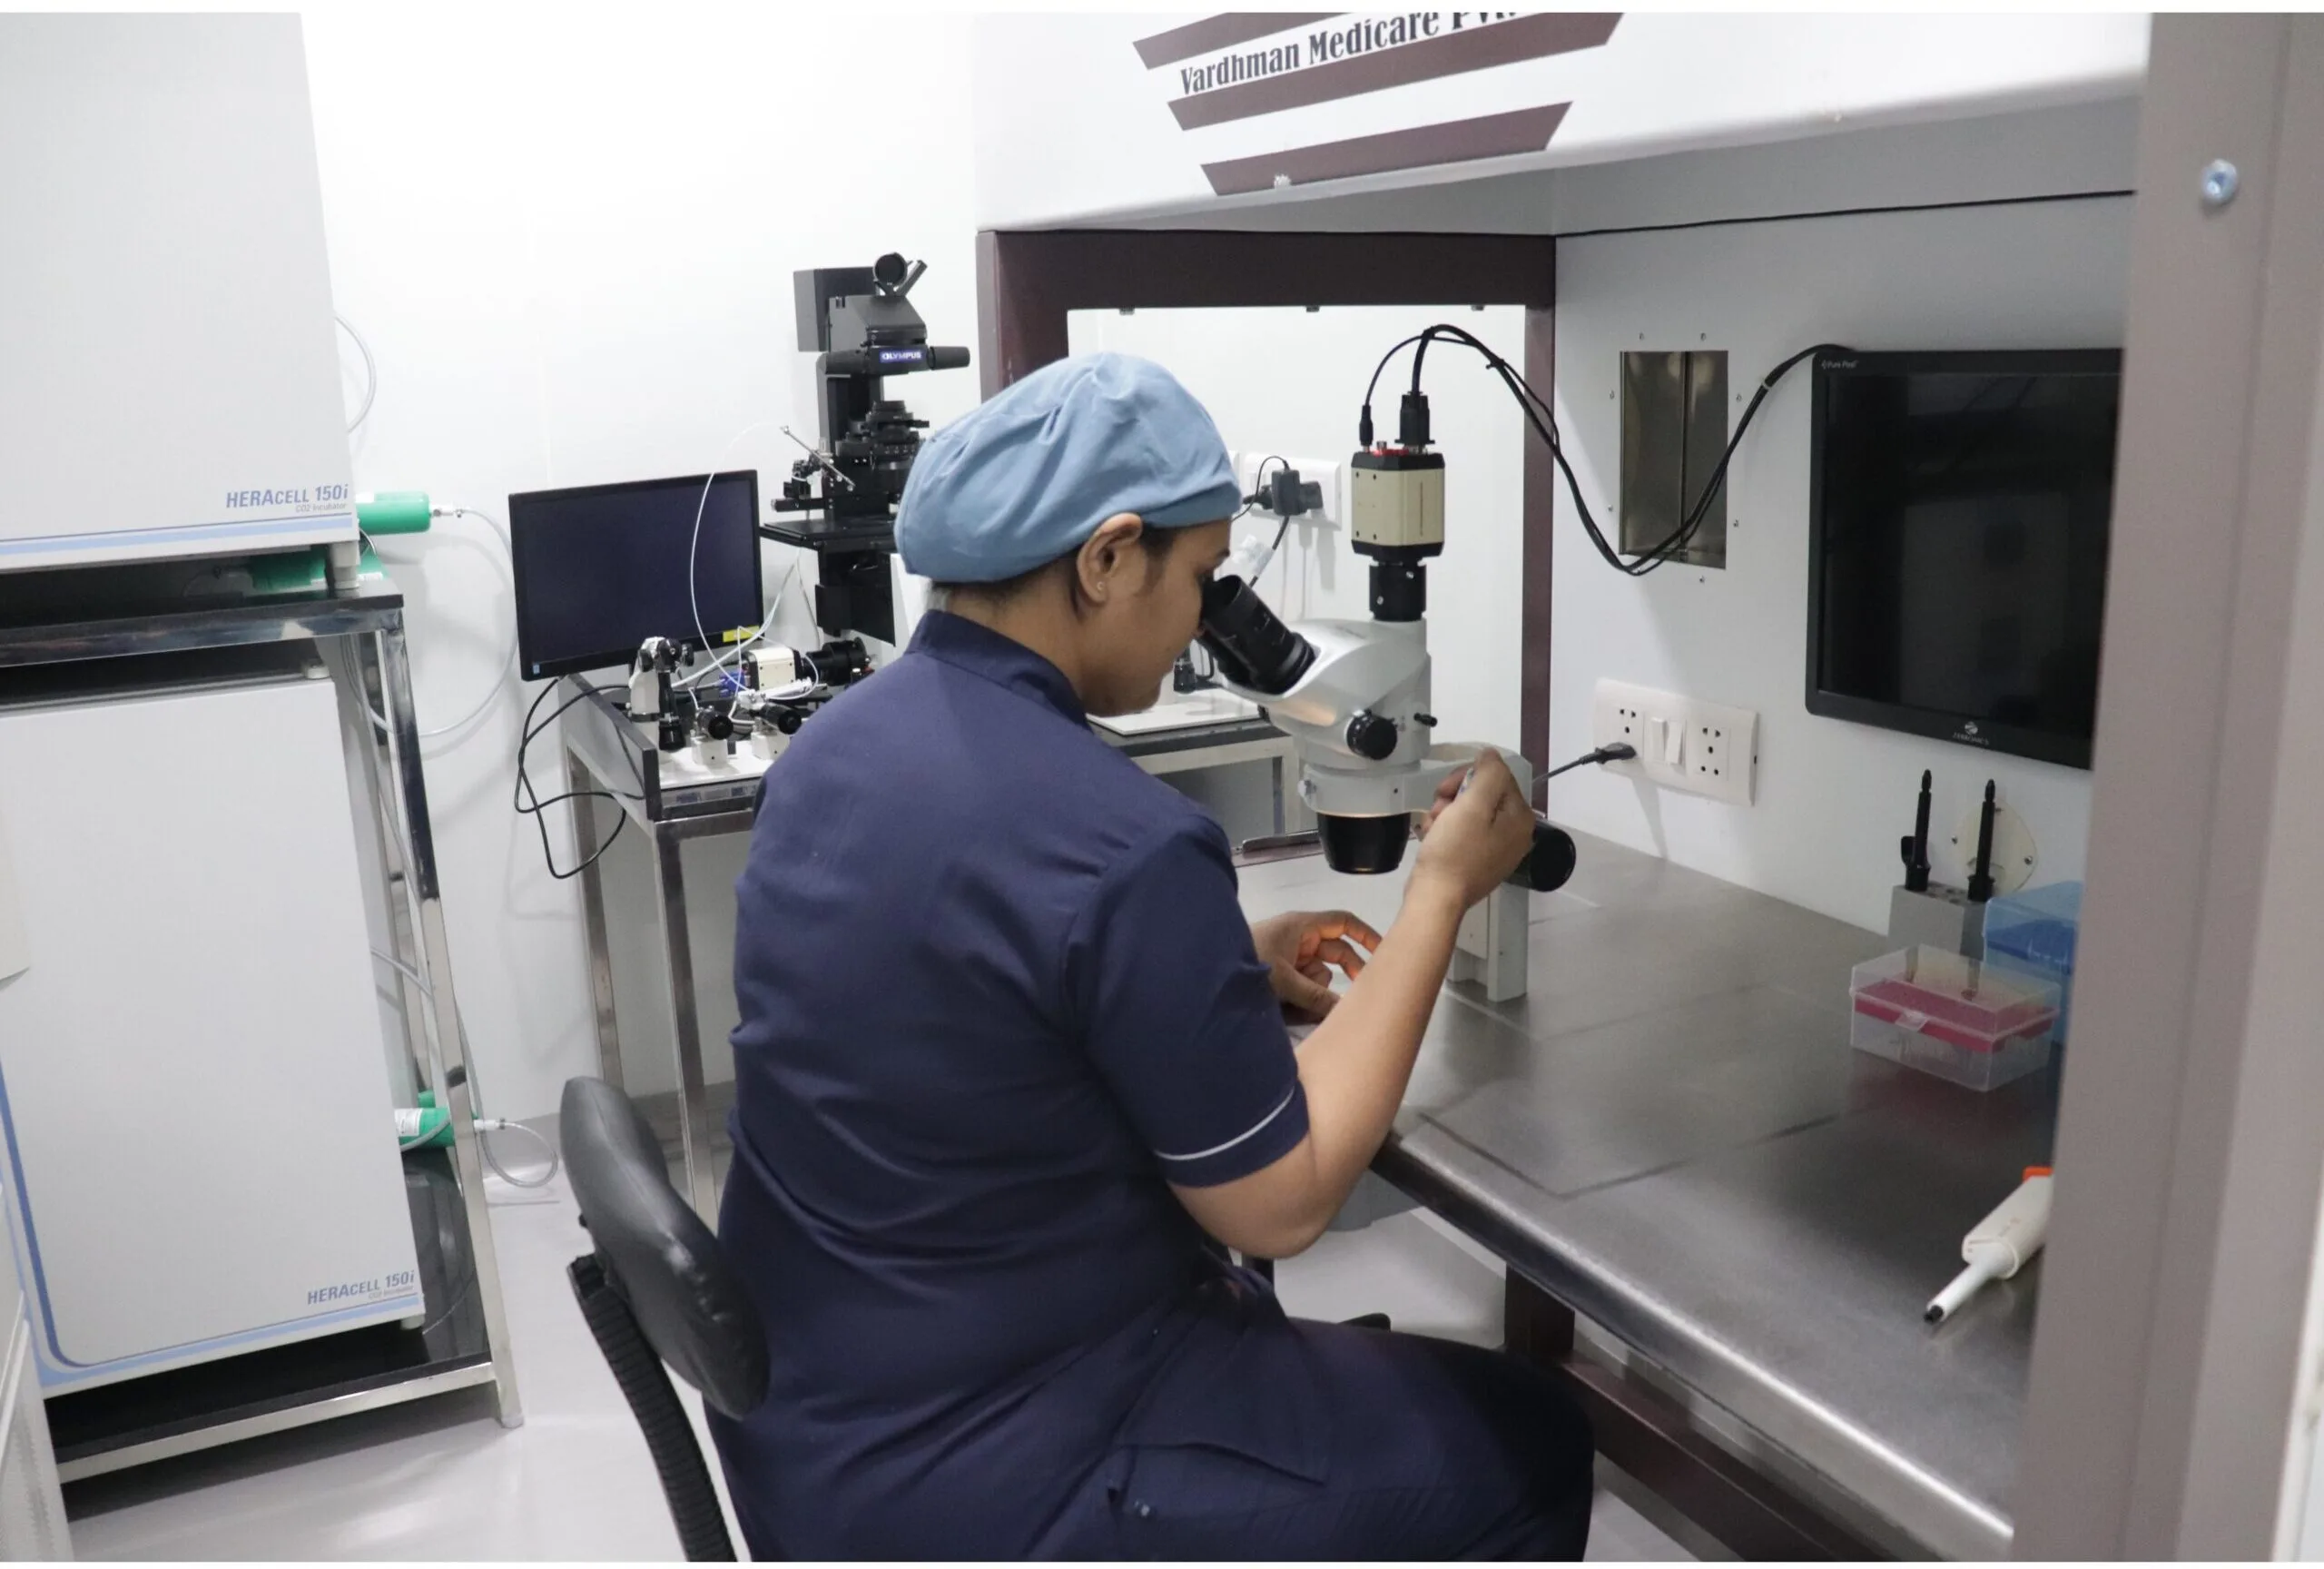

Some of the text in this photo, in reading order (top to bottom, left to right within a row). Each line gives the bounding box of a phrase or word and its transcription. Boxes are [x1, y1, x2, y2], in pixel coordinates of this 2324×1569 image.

[1180, 44, 1300, 95] Vardhman
[1308, 12, 1440, 65] Medicare
[881, 351, 922, 361] OLYMPUS
[314, 483, 349, 501] 150i
[384, 1269, 415, 1288] 150i
